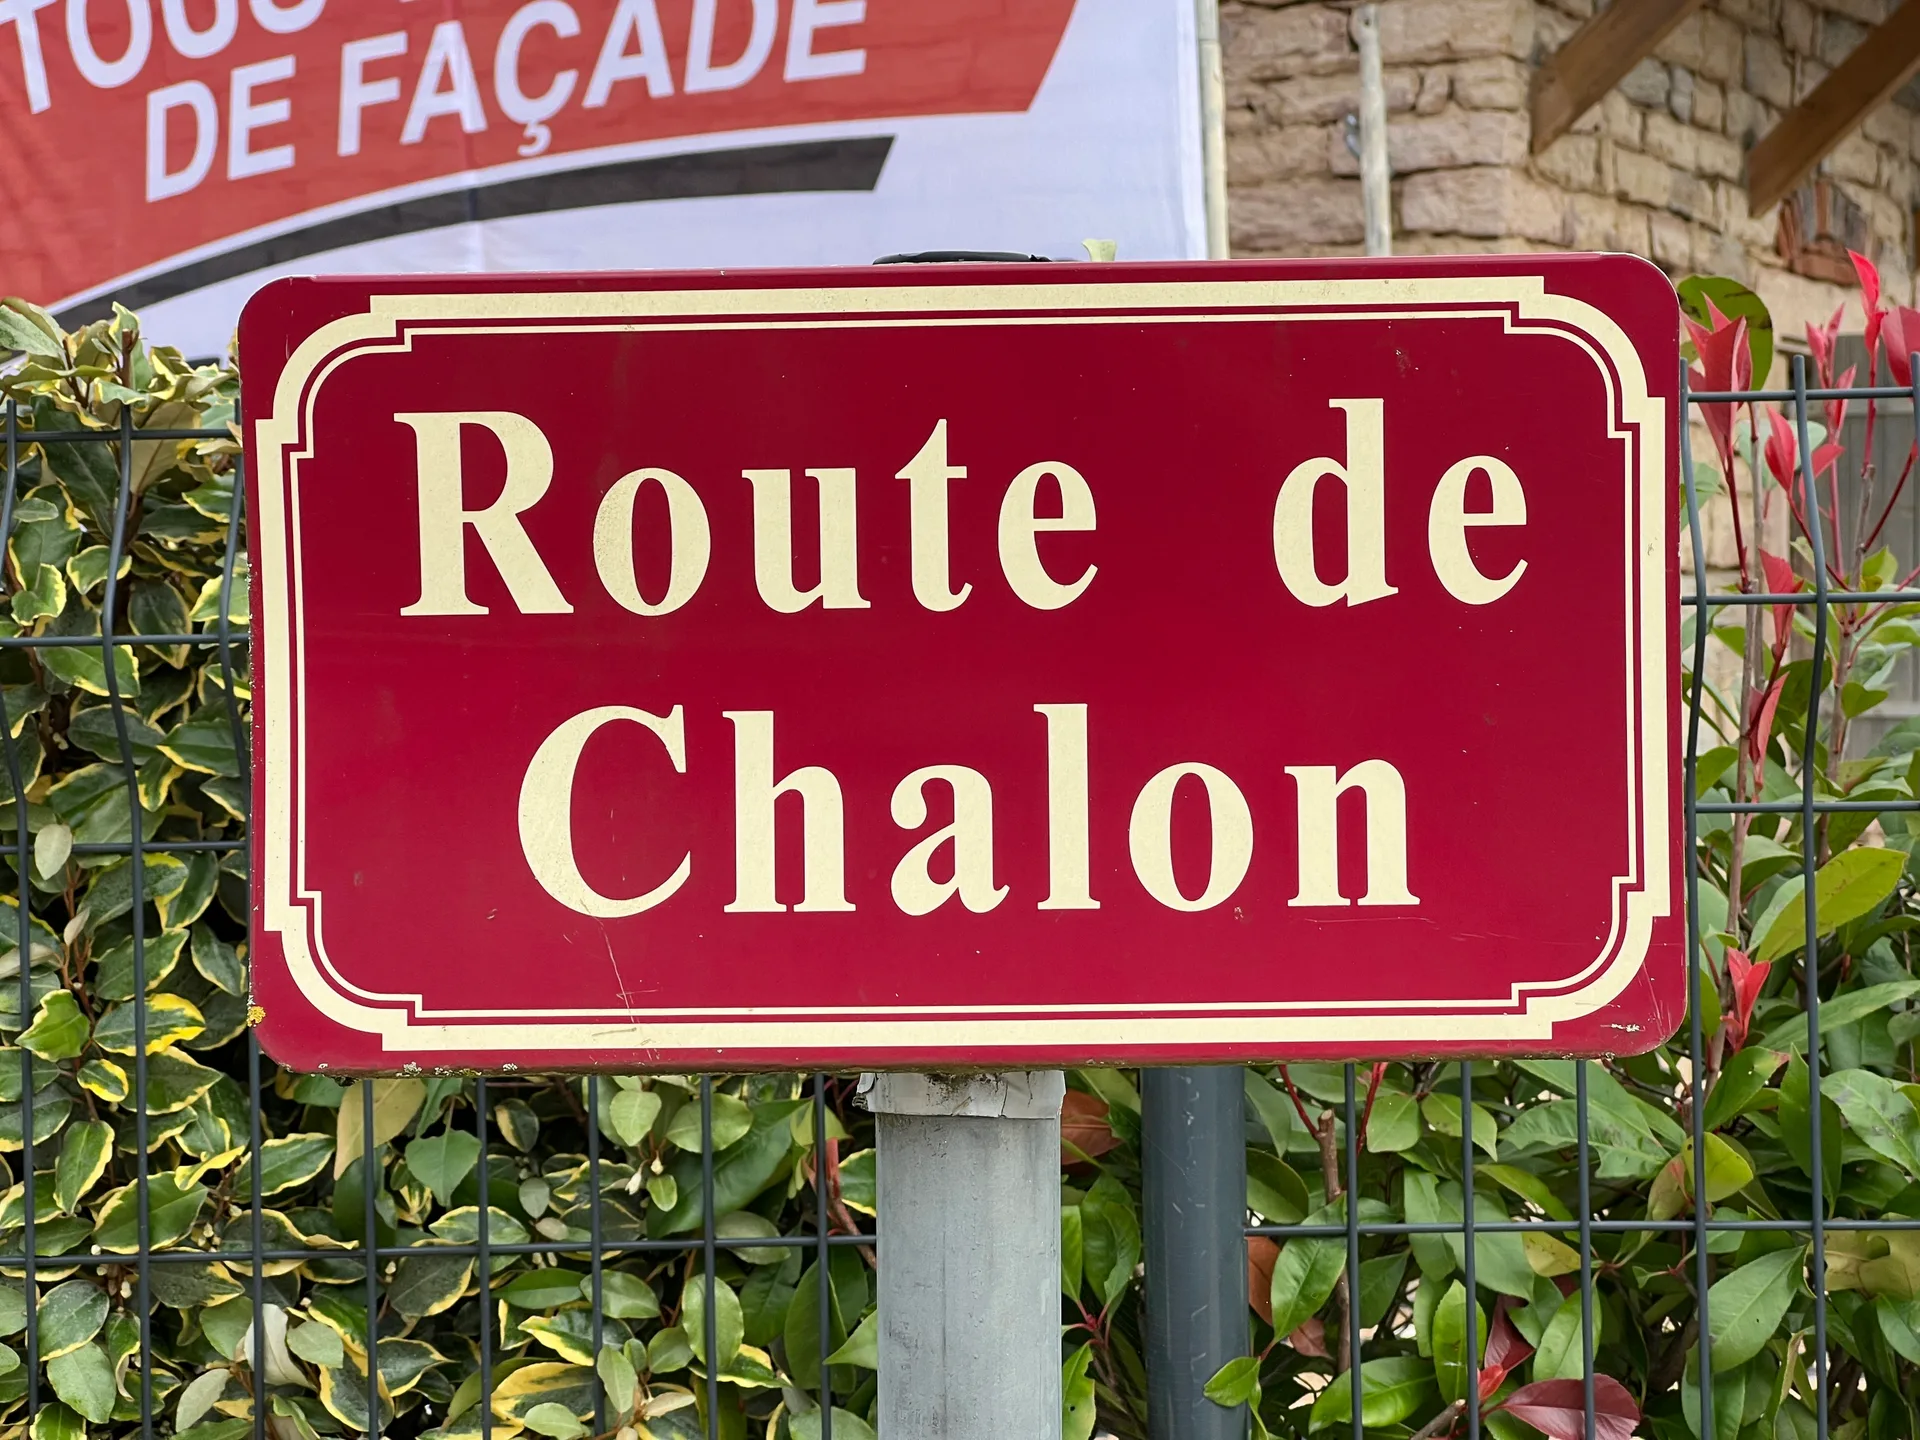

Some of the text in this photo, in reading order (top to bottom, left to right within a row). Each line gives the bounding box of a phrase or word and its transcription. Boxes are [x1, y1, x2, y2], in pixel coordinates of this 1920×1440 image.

[146, 0, 867, 203] DE FAÇADE
[393, 397, 1529, 617] Route de
[517, 702, 1421, 919] Chalon
